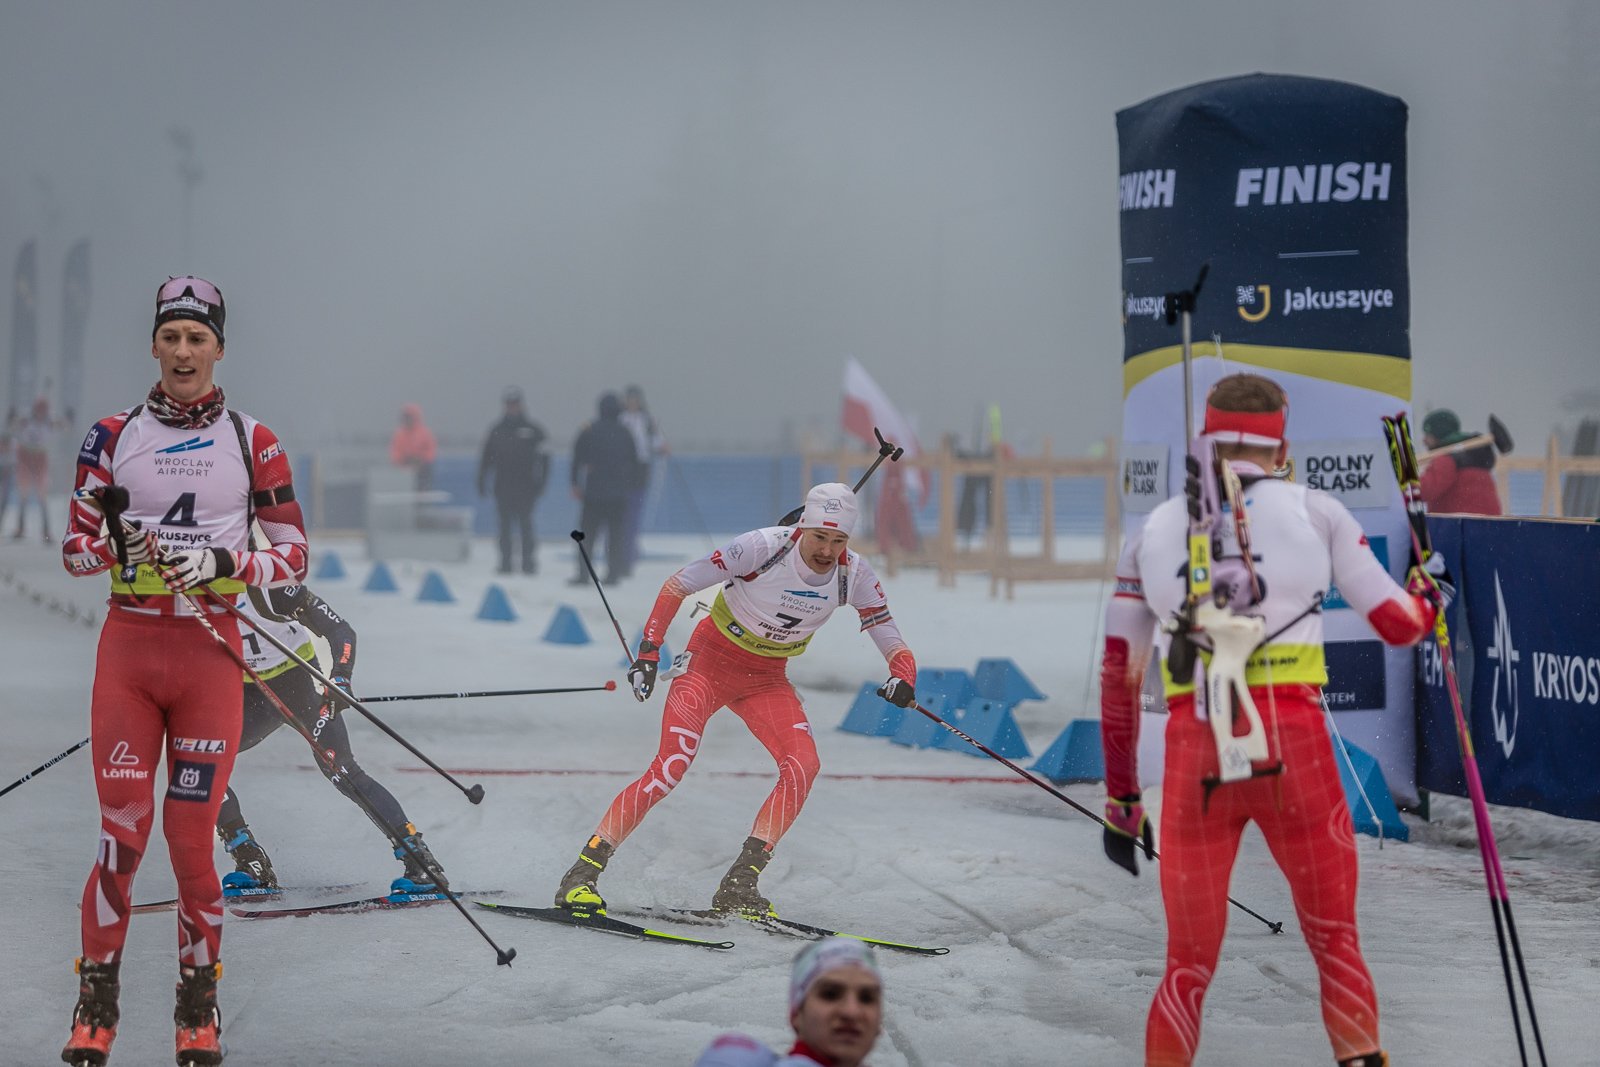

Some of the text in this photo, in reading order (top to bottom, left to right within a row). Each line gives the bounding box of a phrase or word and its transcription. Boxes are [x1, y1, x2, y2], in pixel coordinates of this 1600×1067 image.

[1235, 162, 1391, 206] FINISH
[1283, 287, 1393, 316] Jakuszyce
[154, 458, 214, 468] WROCLAW
[1132, 459, 1159, 476] DOLNY
[1306, 454, 1373, 472] DOLNY
[157, 468, 209, 477] AIRPORT
[1307, 471, 1371, 492] ŚLĄSK
[160, 492, 198, 526] 4
[780, 594, 823, 611] WROCLAW
[780, 602, 816, 615] AIRPORT
[758, 621, 801, 636] Jakuszyce
[776, 612, 803, 630] 7
[174, 738, 225, 753] HELLA
[643, 726, 701, 794] POL
[102, 768, 149, 779] Löffler
[169, 785, 208, 796] Husqvarna
